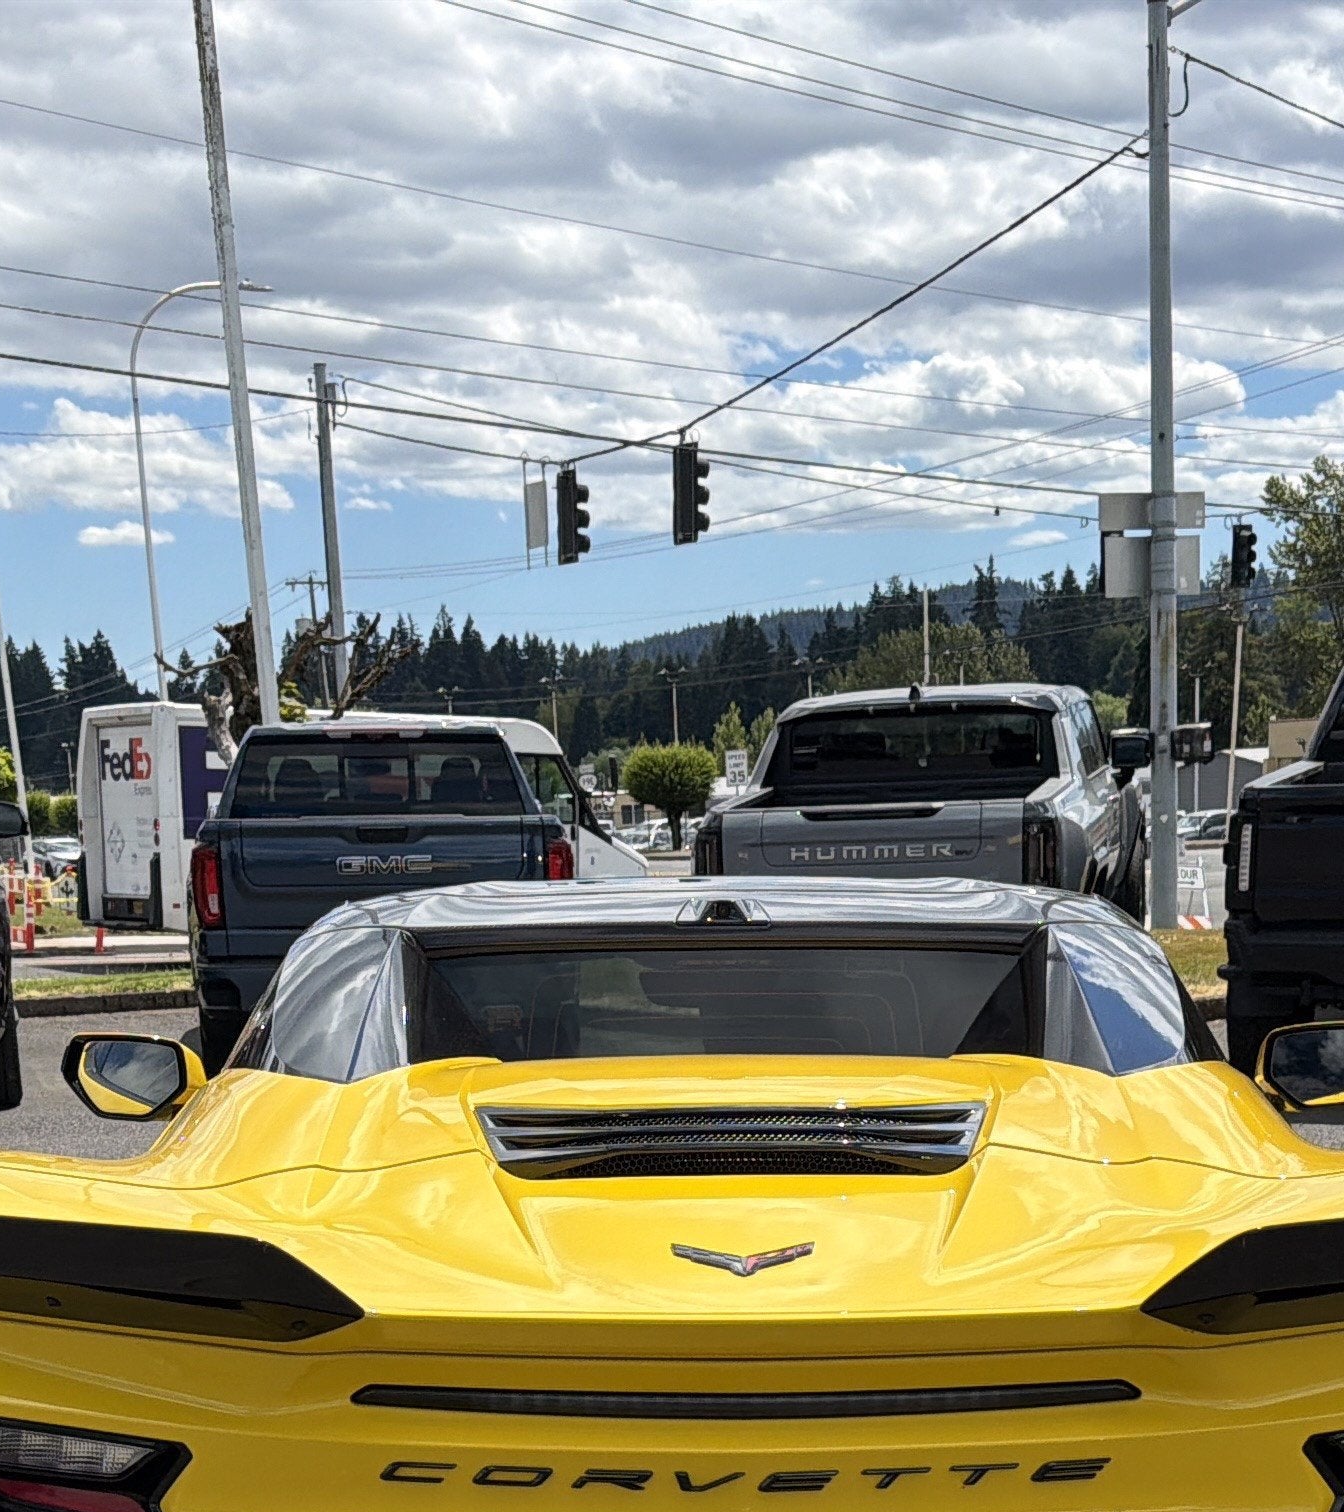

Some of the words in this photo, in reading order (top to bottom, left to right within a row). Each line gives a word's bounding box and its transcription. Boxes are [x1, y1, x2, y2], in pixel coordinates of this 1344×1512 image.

[729, 770, 746, 783] 35
[790, 843, 953, 861] HUMMER
[336, 854, 432, 875] GMC
[379, 1457, 1112, 1492] CORVETTE
